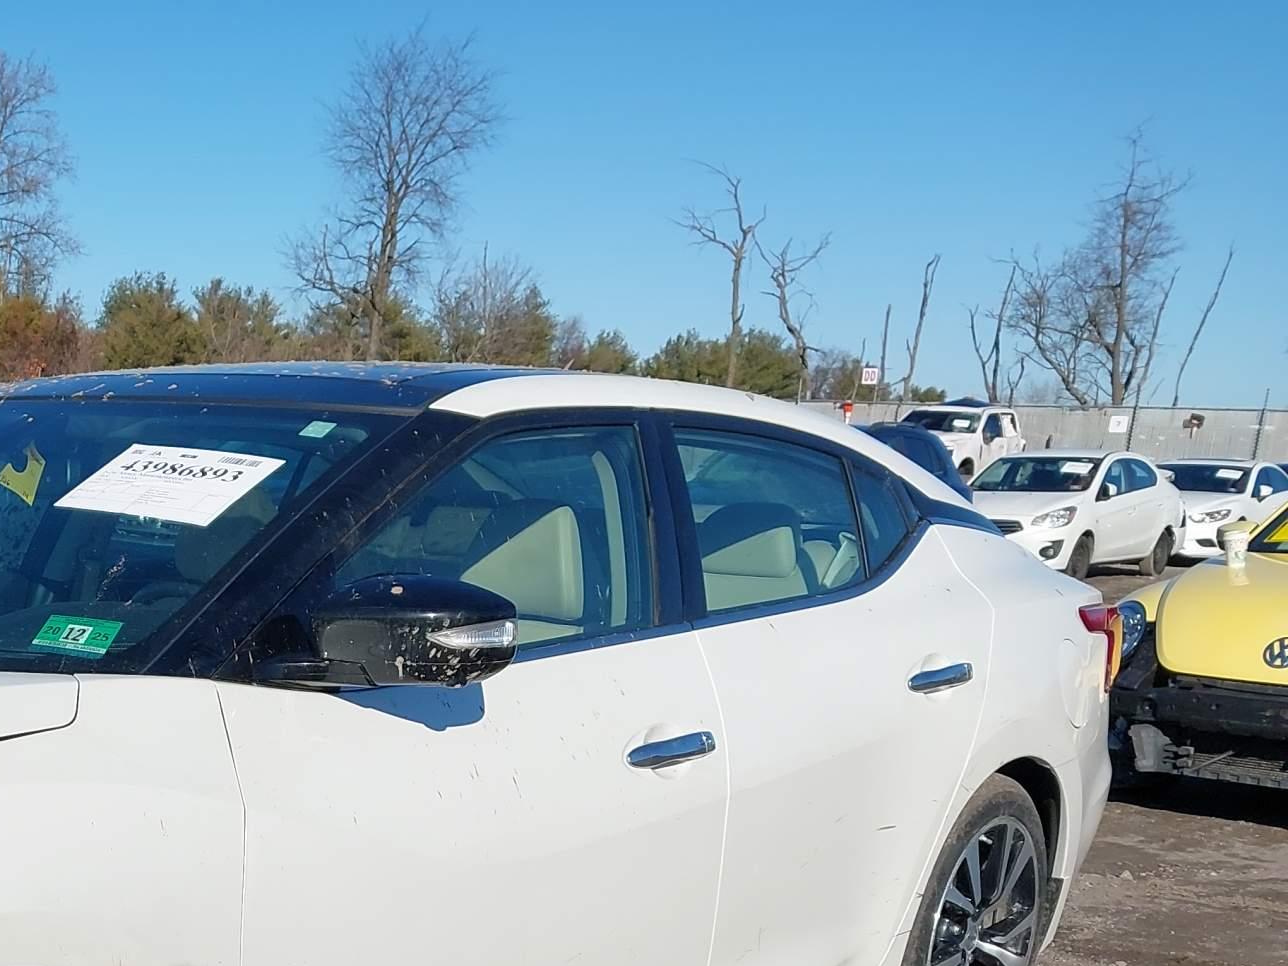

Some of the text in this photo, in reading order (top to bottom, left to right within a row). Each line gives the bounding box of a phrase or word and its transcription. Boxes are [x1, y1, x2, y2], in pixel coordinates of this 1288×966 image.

[864, 371, 877, 382] DD
[120, 459, 244, 483] 43986893
[43, 625, 111, 642] 20 12 25
